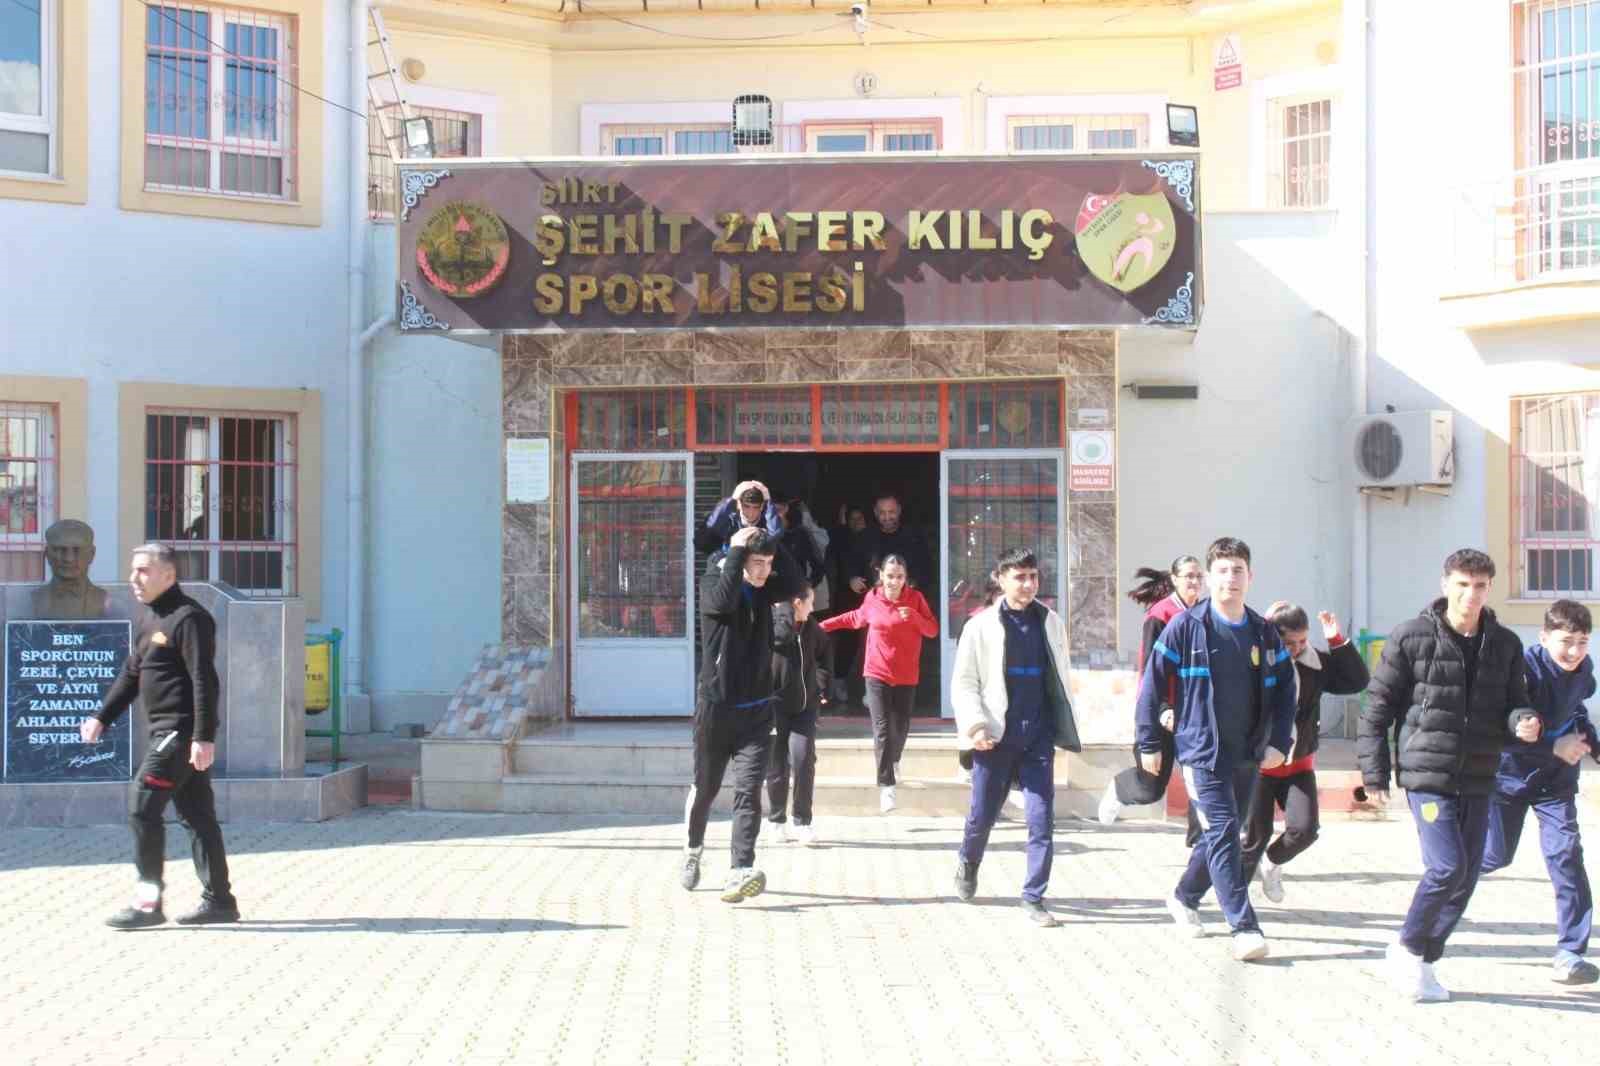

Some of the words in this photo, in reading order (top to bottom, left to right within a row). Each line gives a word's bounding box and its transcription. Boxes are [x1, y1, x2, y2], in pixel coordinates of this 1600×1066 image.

[535, 205, 692, 266] ŞEHİT
[712, 209, 888, 254] ZAFER
[907, 208, 1055, 261] KILIÇ
[533, 271, 676, 315] SPOR
[696, 261, 865, 315] LİSESİ
[53, 635, 84, 646] BEN
[21, 651, 114, 662] SPORCUNUN
[67, 666, 115, 680] ÇEVİK
[36, 684, 57, 694] VE
[62, 684, 98, 694] AYNI
[30, 700, 103, 711] ZAMANDA
